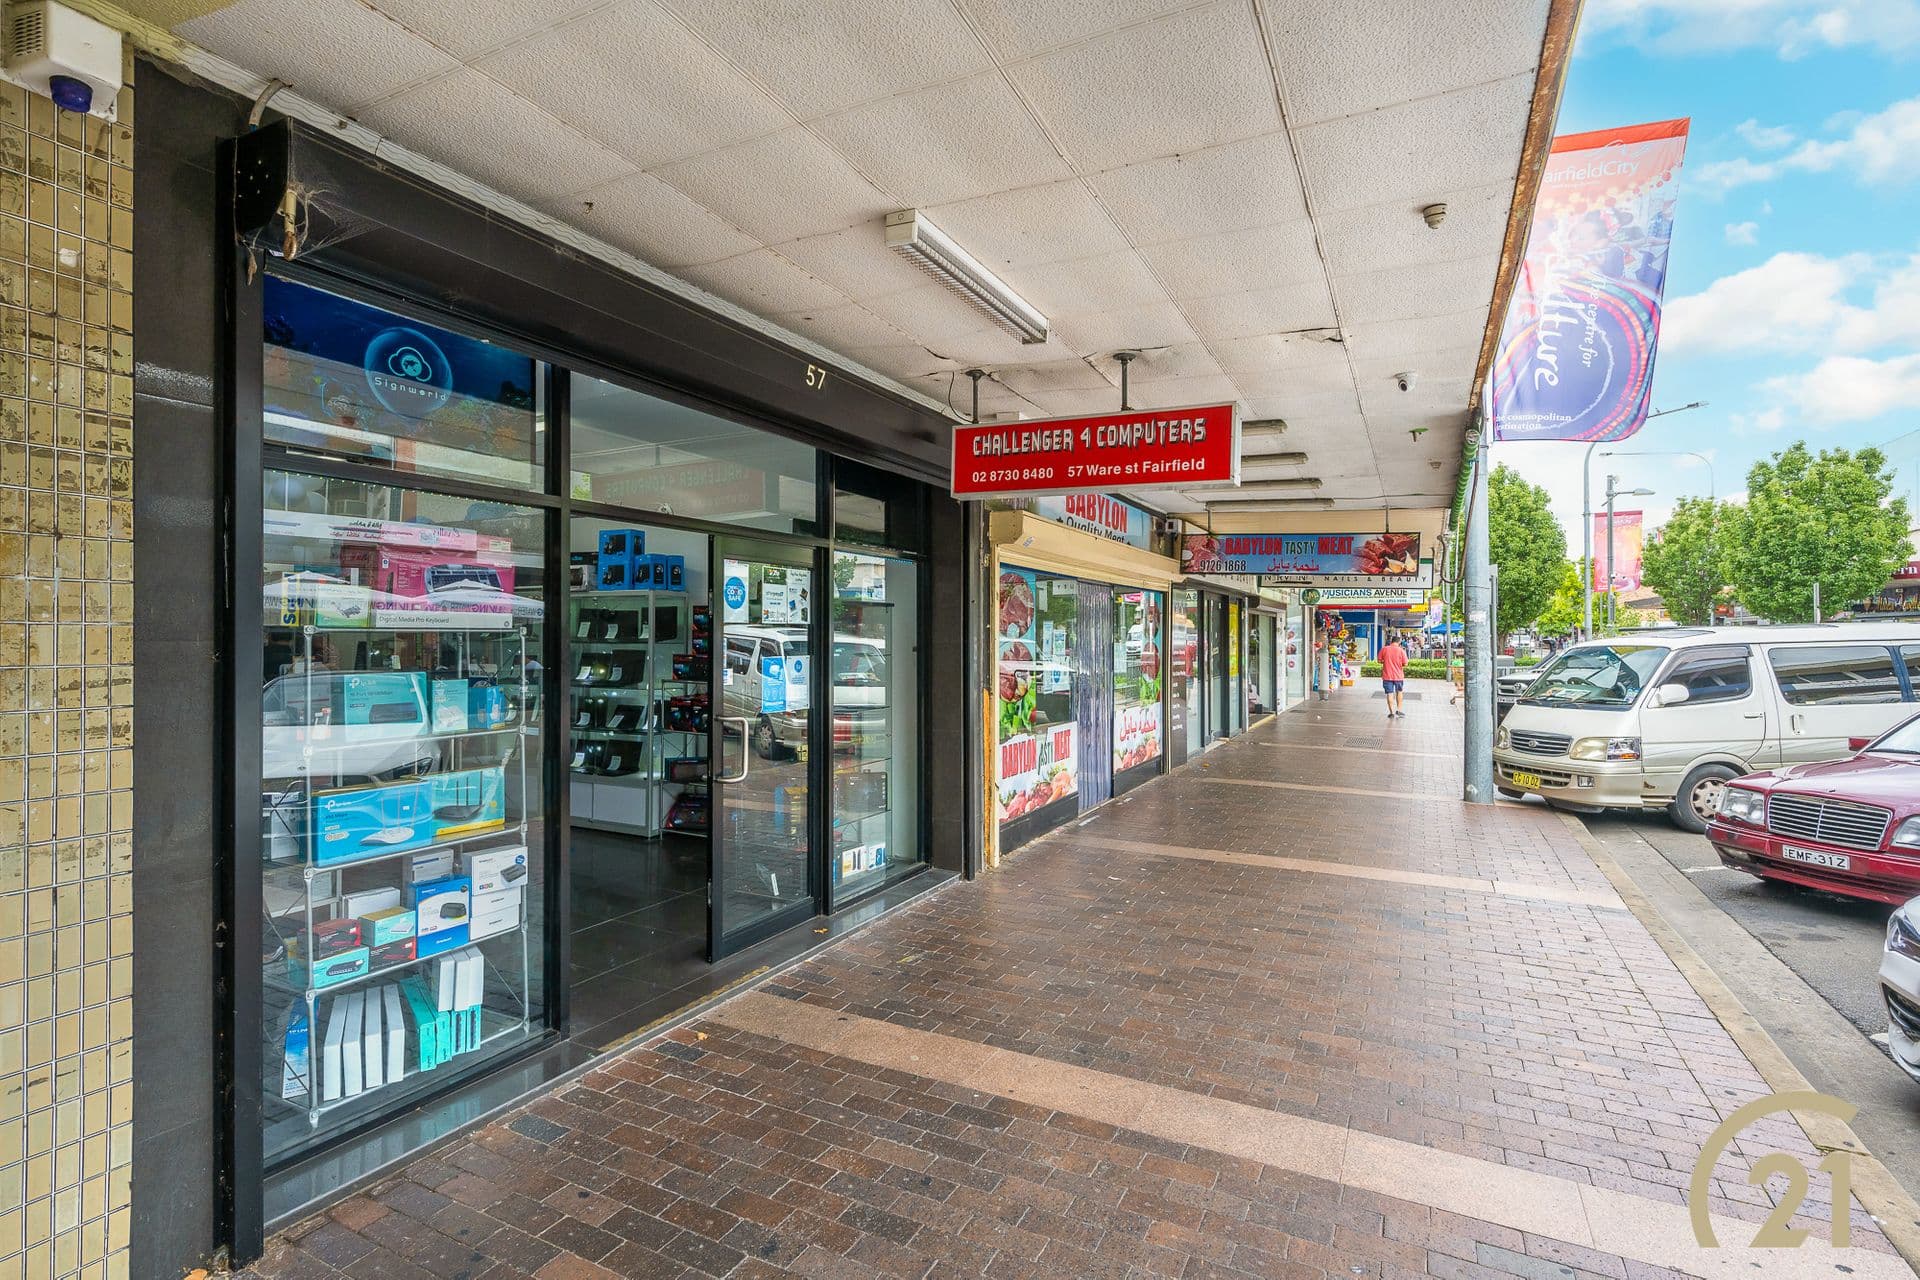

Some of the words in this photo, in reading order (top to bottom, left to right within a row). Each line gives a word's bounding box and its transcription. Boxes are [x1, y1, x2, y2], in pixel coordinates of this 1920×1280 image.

[1543, 160, 1639, 184] airfieldCity
[1578, 344, 1598, 368] for
[374, 377, 447, 401] Signworld
[806, 364, 826, 390] 57
[1507, 411, 1572, 423] cosmopolitan
[972, 426, 1074, 457] CHALLENGER
[1080, 426, 1092, 450] 4
[1096, 417, 1207, 449] COMPUTERS
[972, 471, 987, 483] 02
[990, 469, 1020, 482] 8730
[1023, 467, 1054, 480] 8480
[1068, 465, 1083, 478] 57
[1086, 463, 1121, 477] Ware
[1125, 462, 1139, 475] st
[1142, 457, 1205, 474] Fairfield
[1066, 494, 1128, 533] BABYLON
[1225, 537, 1283, 555] BABYLON
[1285, 541, 1316, 555] TASTY
[1317, 536, 1355, 555] MEAT
[1200, 560, 1222, 572] 9726
[1225, 559, 1247, 572] 1868
[1321, 588, 1372, 600] MUSICIANS
[1374, 589, 1408, 597] AVENUE
[1002, 738, 1037, 780] BABYLON
[1054, 729, 1071, 763] MEAT
